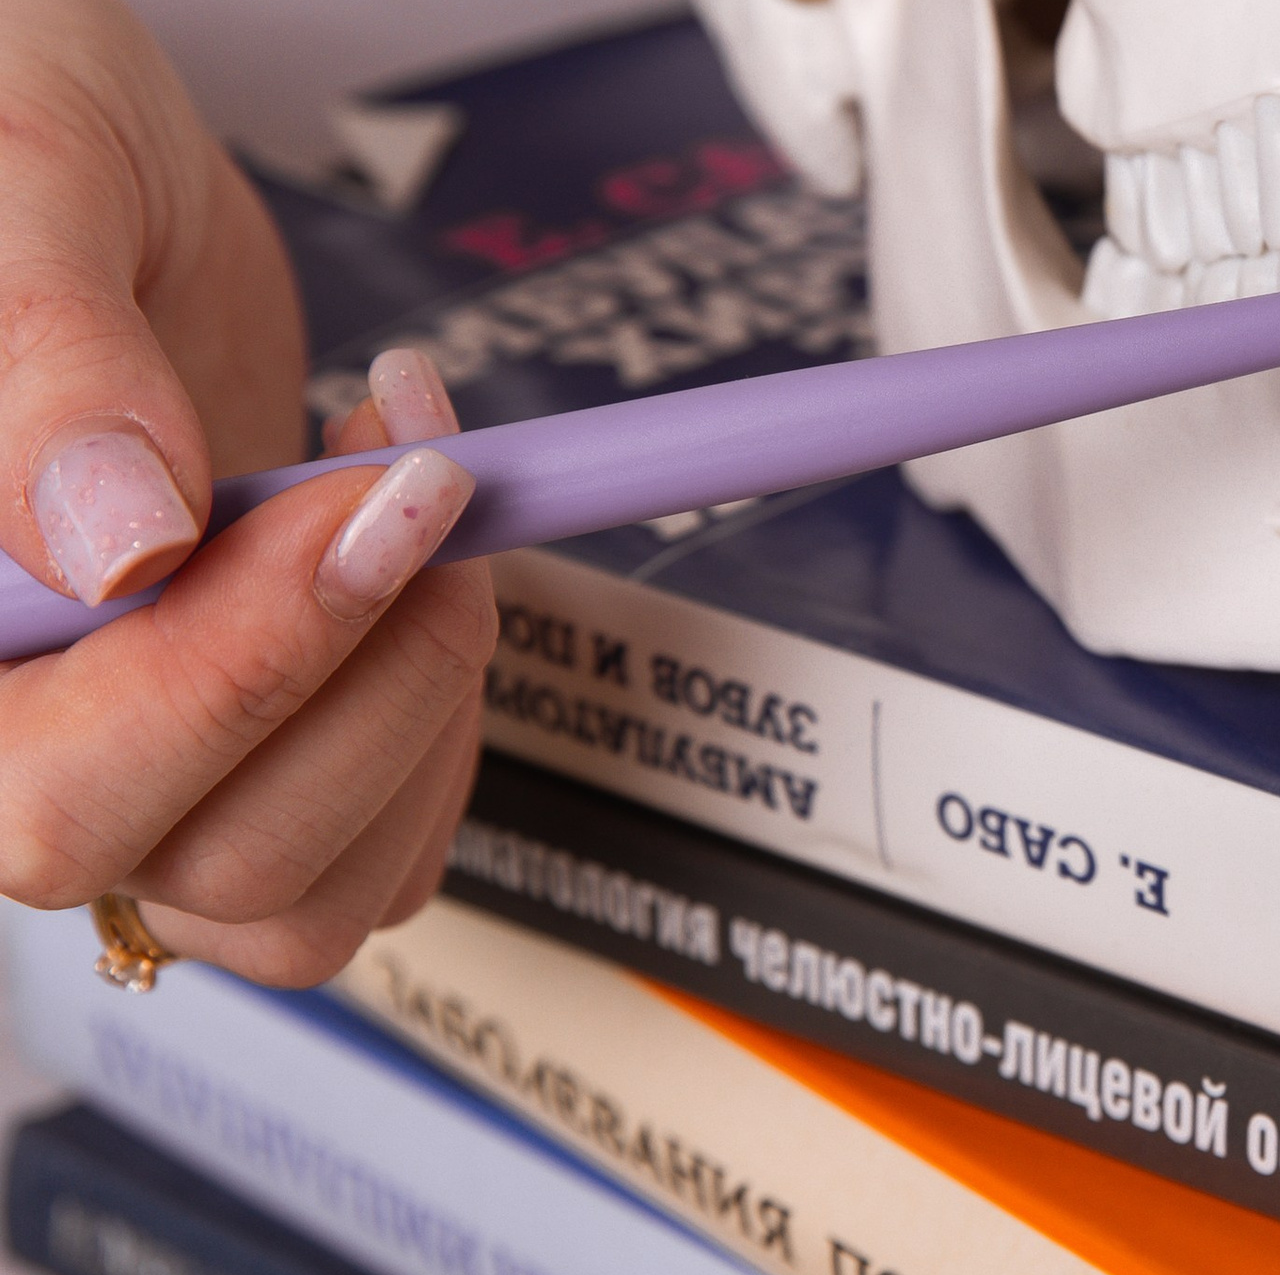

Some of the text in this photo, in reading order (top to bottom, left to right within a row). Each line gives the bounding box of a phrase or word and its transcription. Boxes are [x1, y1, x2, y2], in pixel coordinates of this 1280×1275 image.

[594, 633, 631, 689] И
[651, 654, 818, 755] ЗУБОВ
[936, 791, 1170, 918] Е. САБО
[449, 820, 722, 967] матология
[728, 914, 1231, 1161] челюстно-лицевой
[373, 946, 802, 1271] ЗАБОЛЕВАНИЯ
